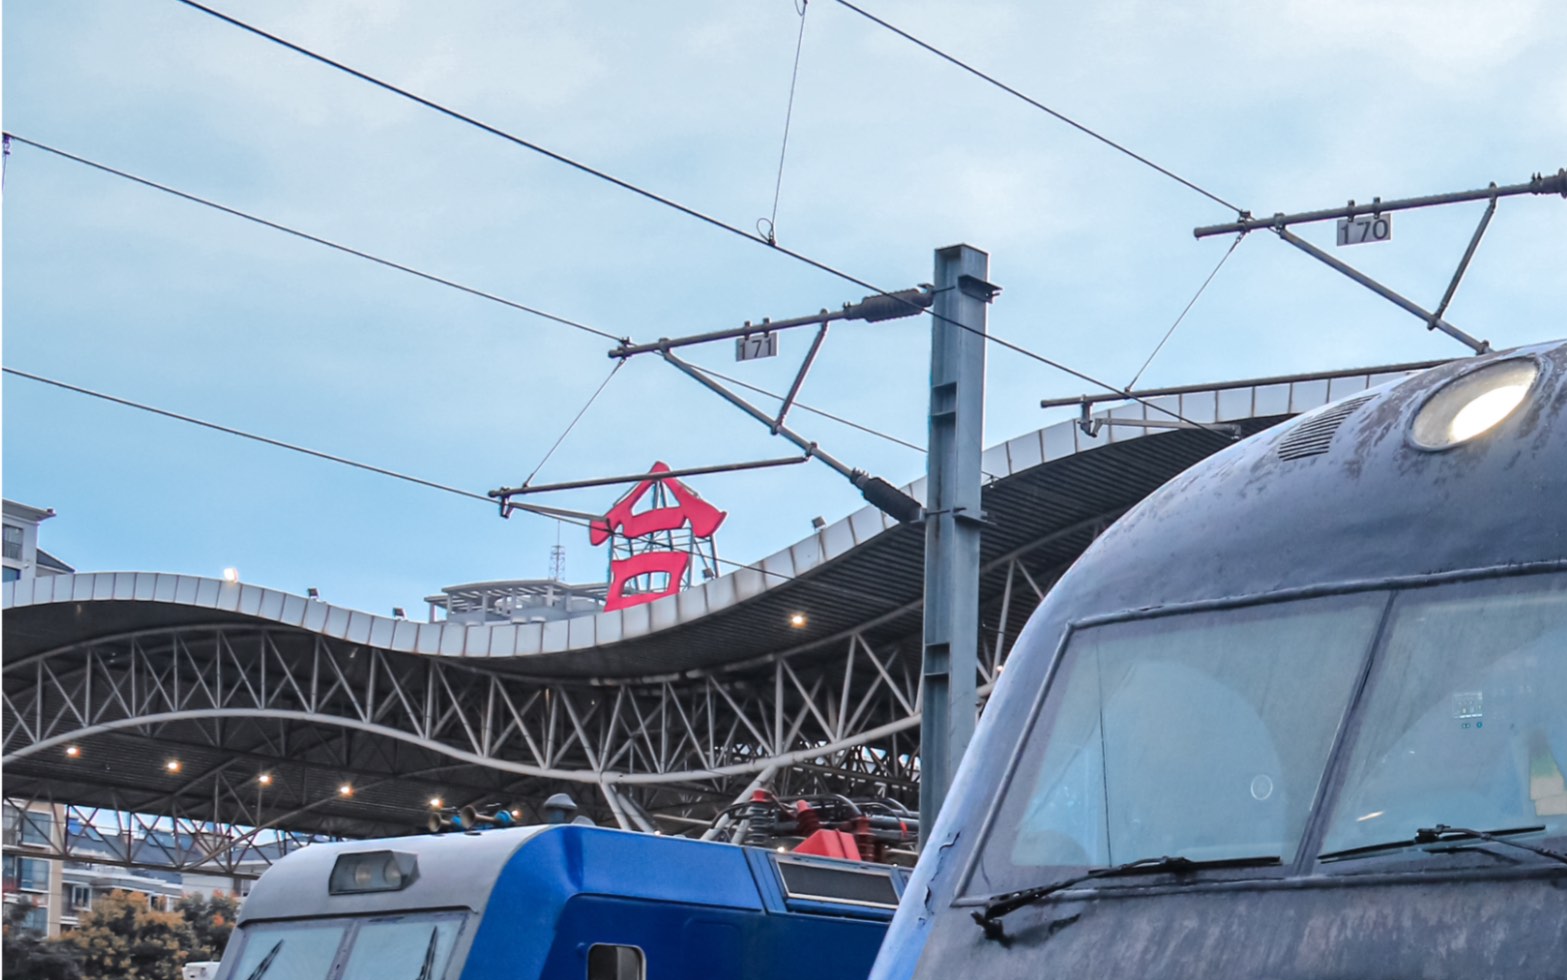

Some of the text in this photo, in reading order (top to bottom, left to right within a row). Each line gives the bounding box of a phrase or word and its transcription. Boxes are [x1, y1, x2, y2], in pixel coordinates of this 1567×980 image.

[1340, 218, 1389, 245] 170
[740, 338, 772, 359] 171
[590, 461, 727, 612] 合
